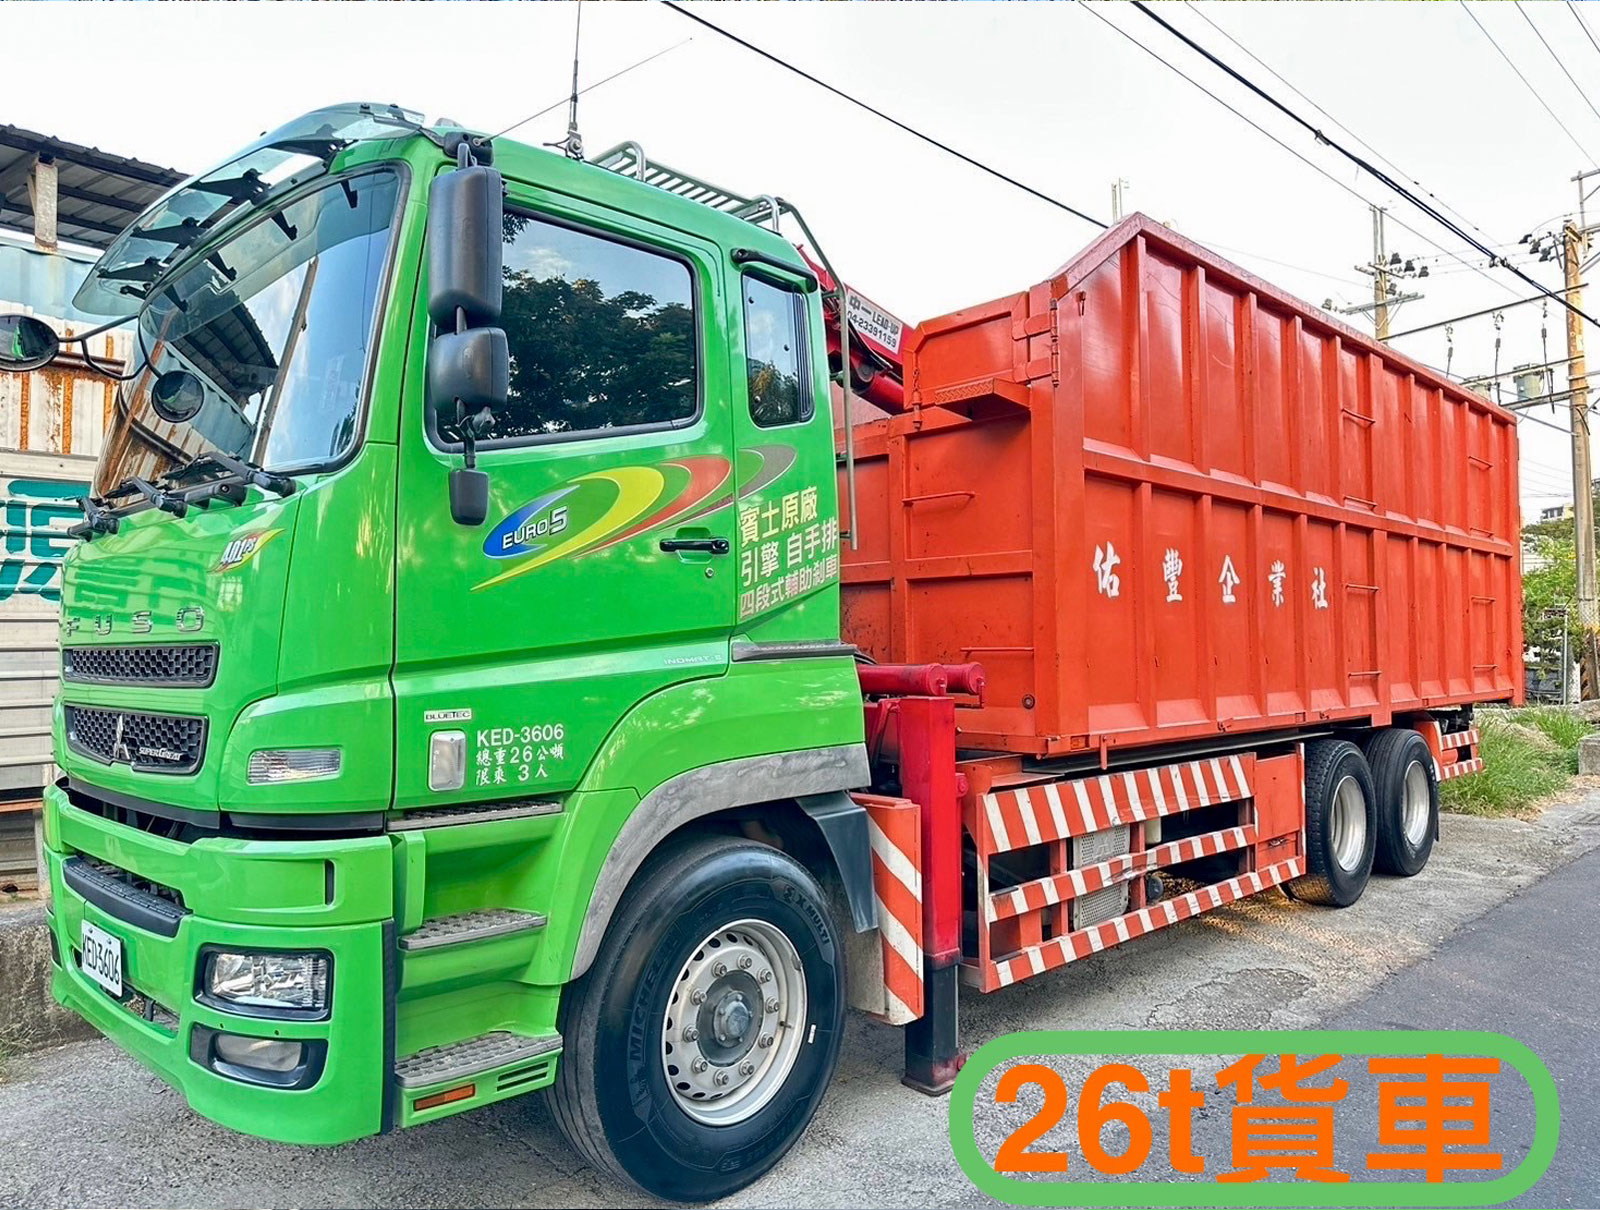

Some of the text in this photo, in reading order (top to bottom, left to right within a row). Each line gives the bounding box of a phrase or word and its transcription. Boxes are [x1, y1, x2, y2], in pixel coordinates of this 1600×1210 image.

[872, 311, 899, 335] LEAD-UP
[740, 486, 818, 547] 賓士原廠
[66, 606, 204, 637] FUSO
[476, 723, 564, 747] KED-3606
[805, 904, 830, 945] MULTI
